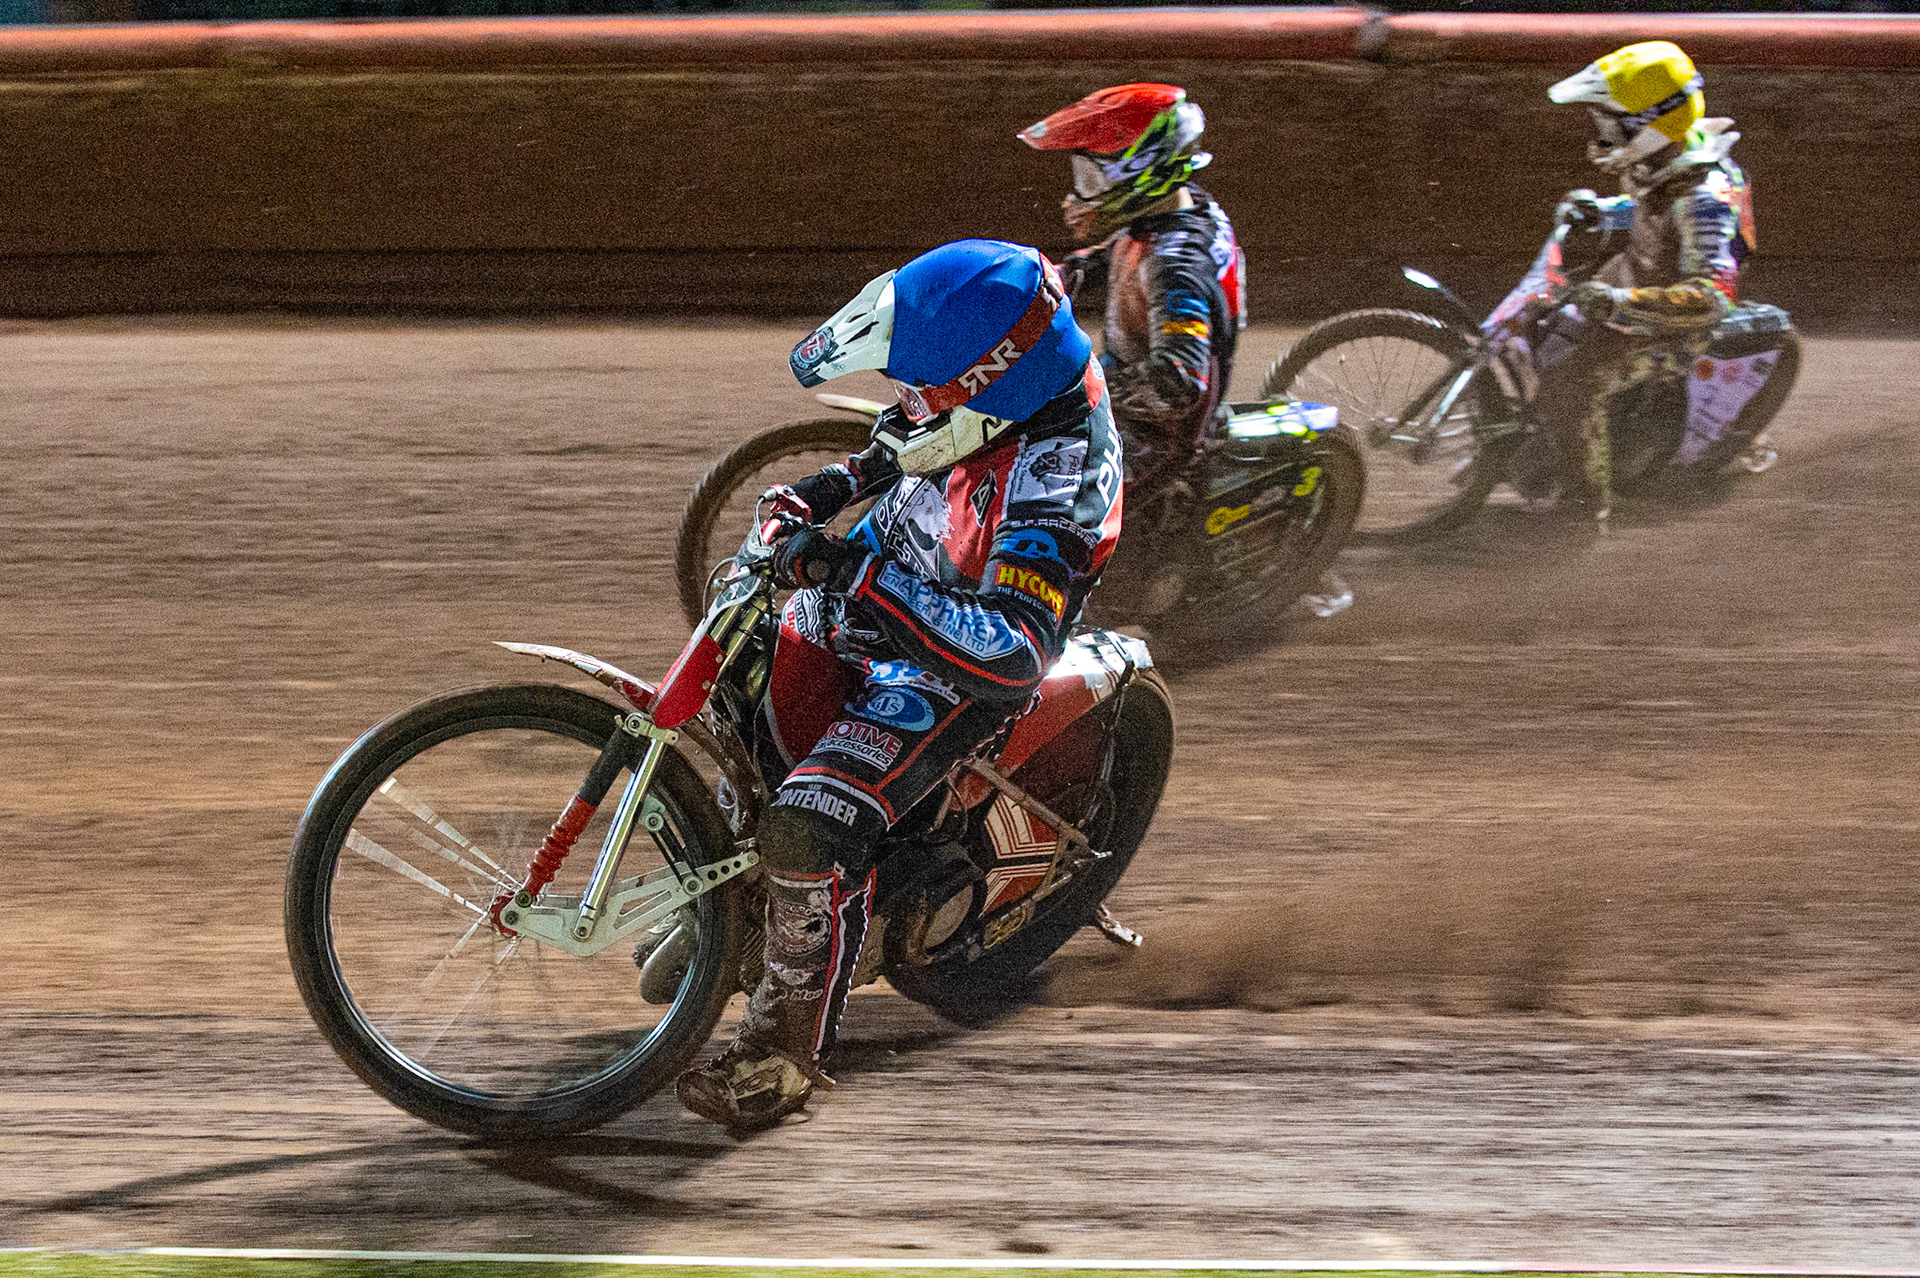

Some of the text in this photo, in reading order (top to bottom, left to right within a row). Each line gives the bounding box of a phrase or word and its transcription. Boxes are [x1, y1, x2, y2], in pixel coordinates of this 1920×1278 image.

[997, 586, 1012, 596] THE
[965, 634, 985, 652] LTD
[827, 738, 893, 766] accessories
